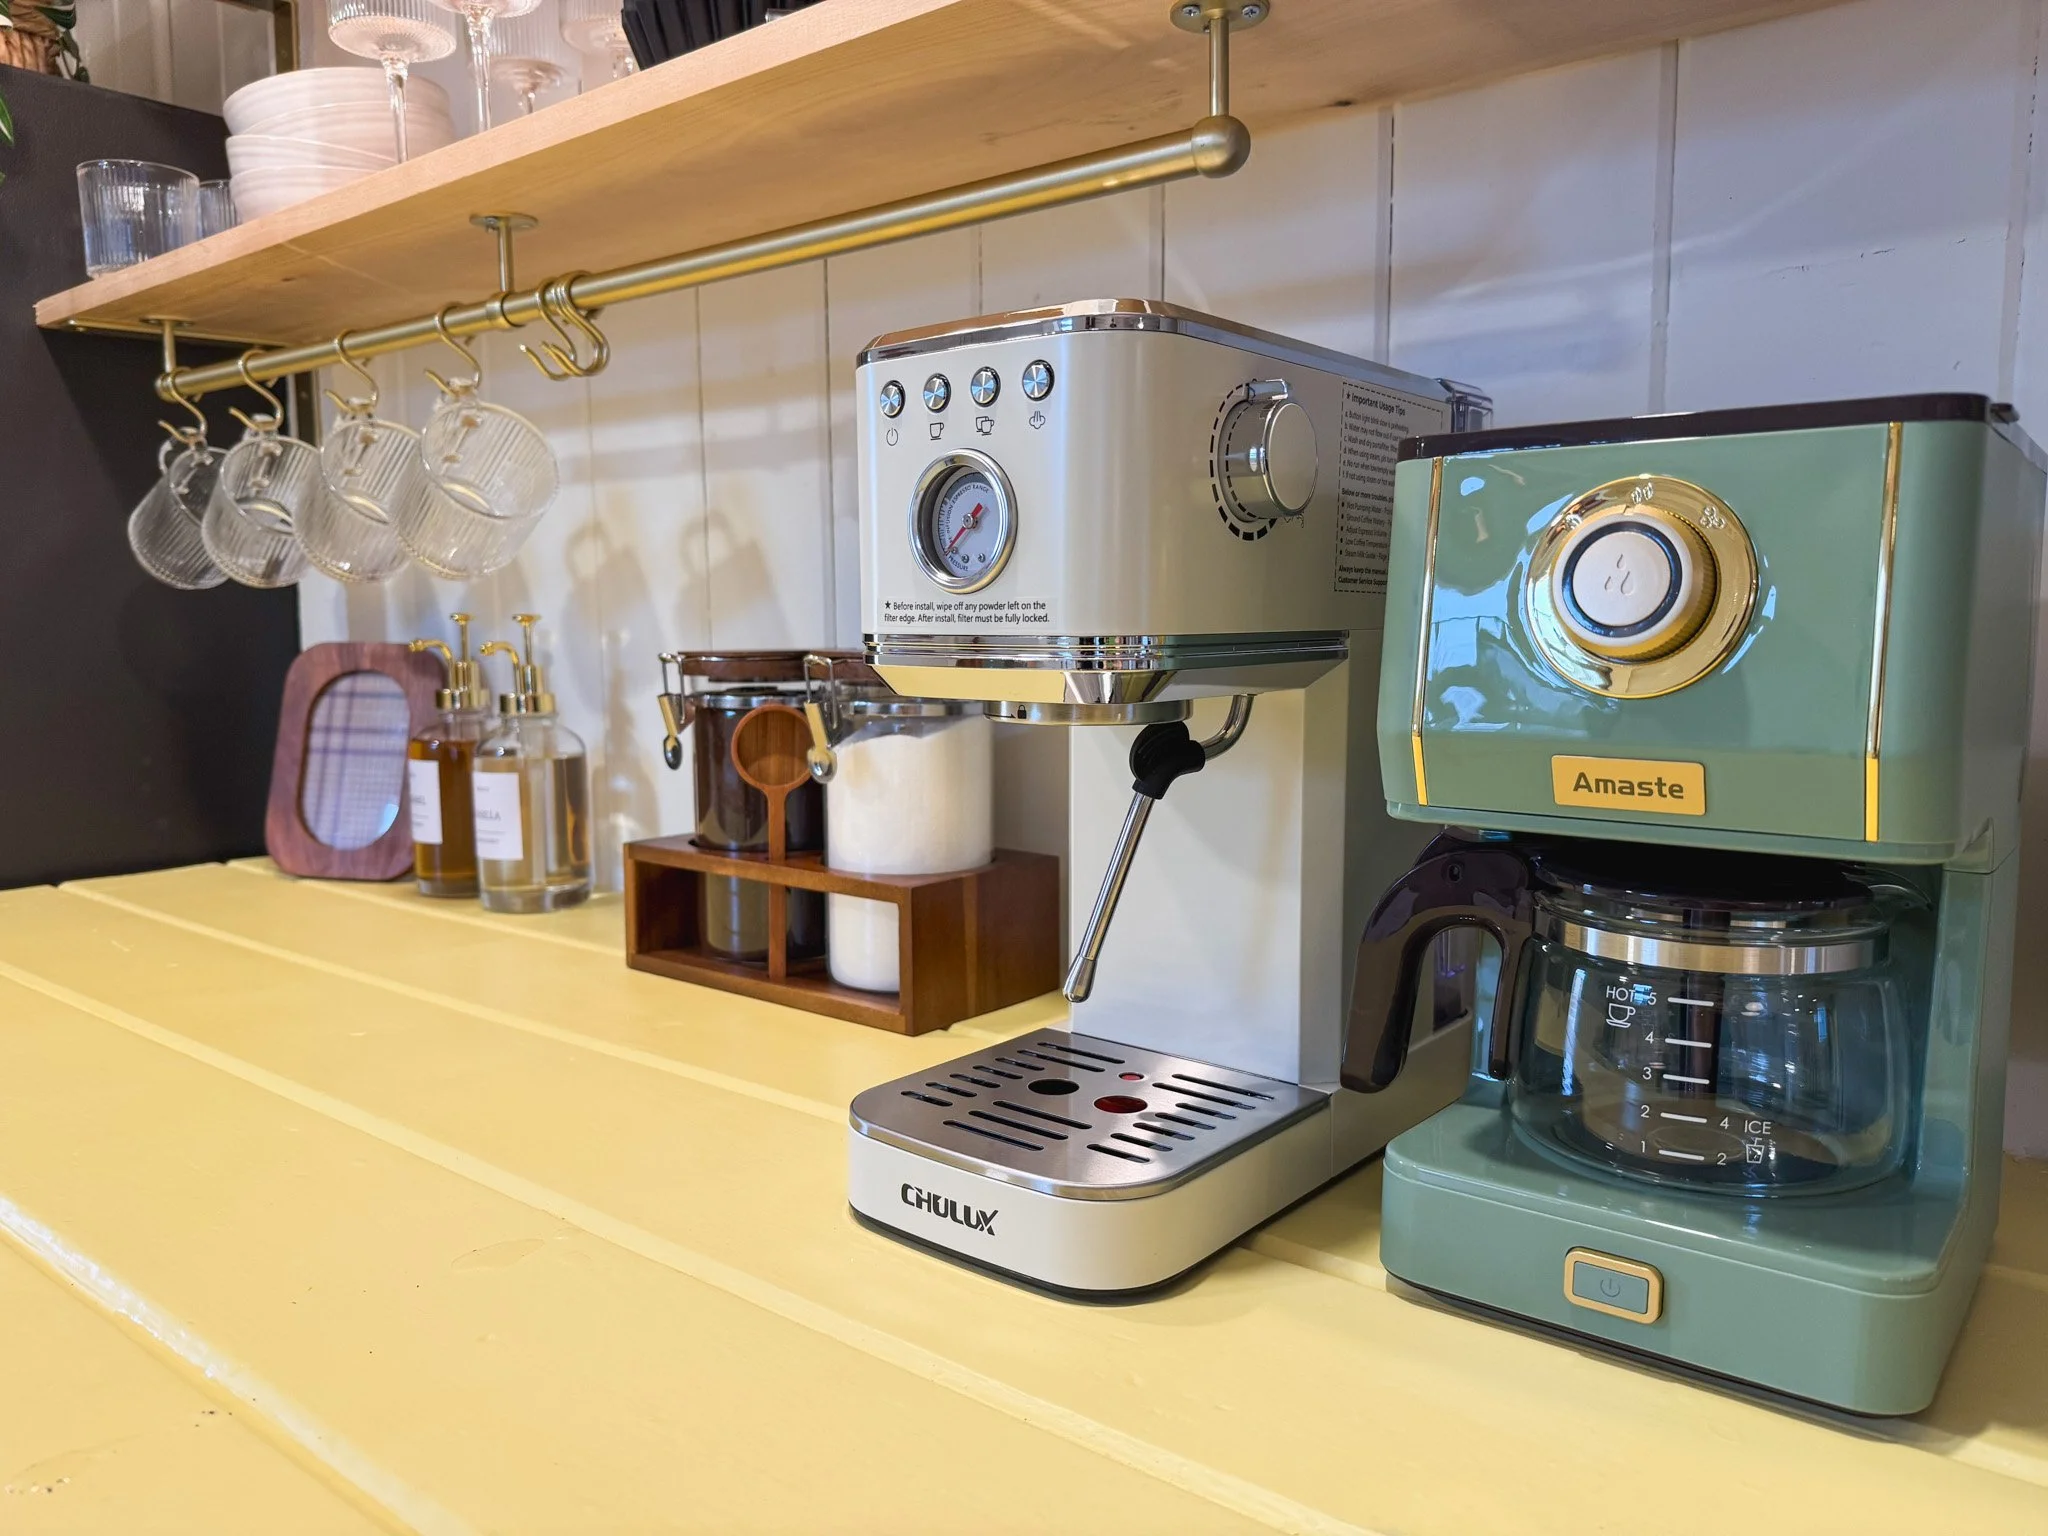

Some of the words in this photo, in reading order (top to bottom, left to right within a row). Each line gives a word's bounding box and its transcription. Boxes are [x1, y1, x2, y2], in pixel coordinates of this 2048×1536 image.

[1352, 393, 1379, 408] Important
[1379, 401, 1395, 414] Usage
[1395, 405, 1406, 416] Tips
[1339, 565, 1354, 574] Always
[1338, 576, 1359, 584] Customer
[1359, 577, 1373, 585] Service
[893, 602, 914, 611] Before
[914, 602, 935, 611] install,
[936, 602, 953, 612] wipe
[953, 601, 964, 610] off
[965, 603, 977, 613] any
[979, 601, 1006, 613] powder
[1007, 601, 1019, 610] left
[1033, 601, 1046, 610] the
[884, 613, 898, 622] filter
[899, 614, 916, 624] edge.
[917, 613, 934, 622] After
[935, 614, 956, 623] install,
[957, 613, 973, 622] filter
[975, 615, 993, 623] must
[994, 613, 1004, 622] be
[1005, 613, 1021, 625] fully
[1022, 613, 1050, 623] locked.
[1573, 772, 1685, 800] Amaste
[1606, 985, 1636, 1003] HOT
[1646, 992, 1658, 1006] 5
[1644, 1031, 1654, 1044] 4
[1642, 1067, 1652, 1081] 3
[1640, 1104, 1650, 1118] 2
[1720, 1116, 1730, 1130] 4
[1743, 1120, 1772, 1135] ICE
[1641, 1140, 1646, 1153] 1
[1717, 1152, 1727, 1166] 2
[901, 1183, 999, 1236] CHULUX
